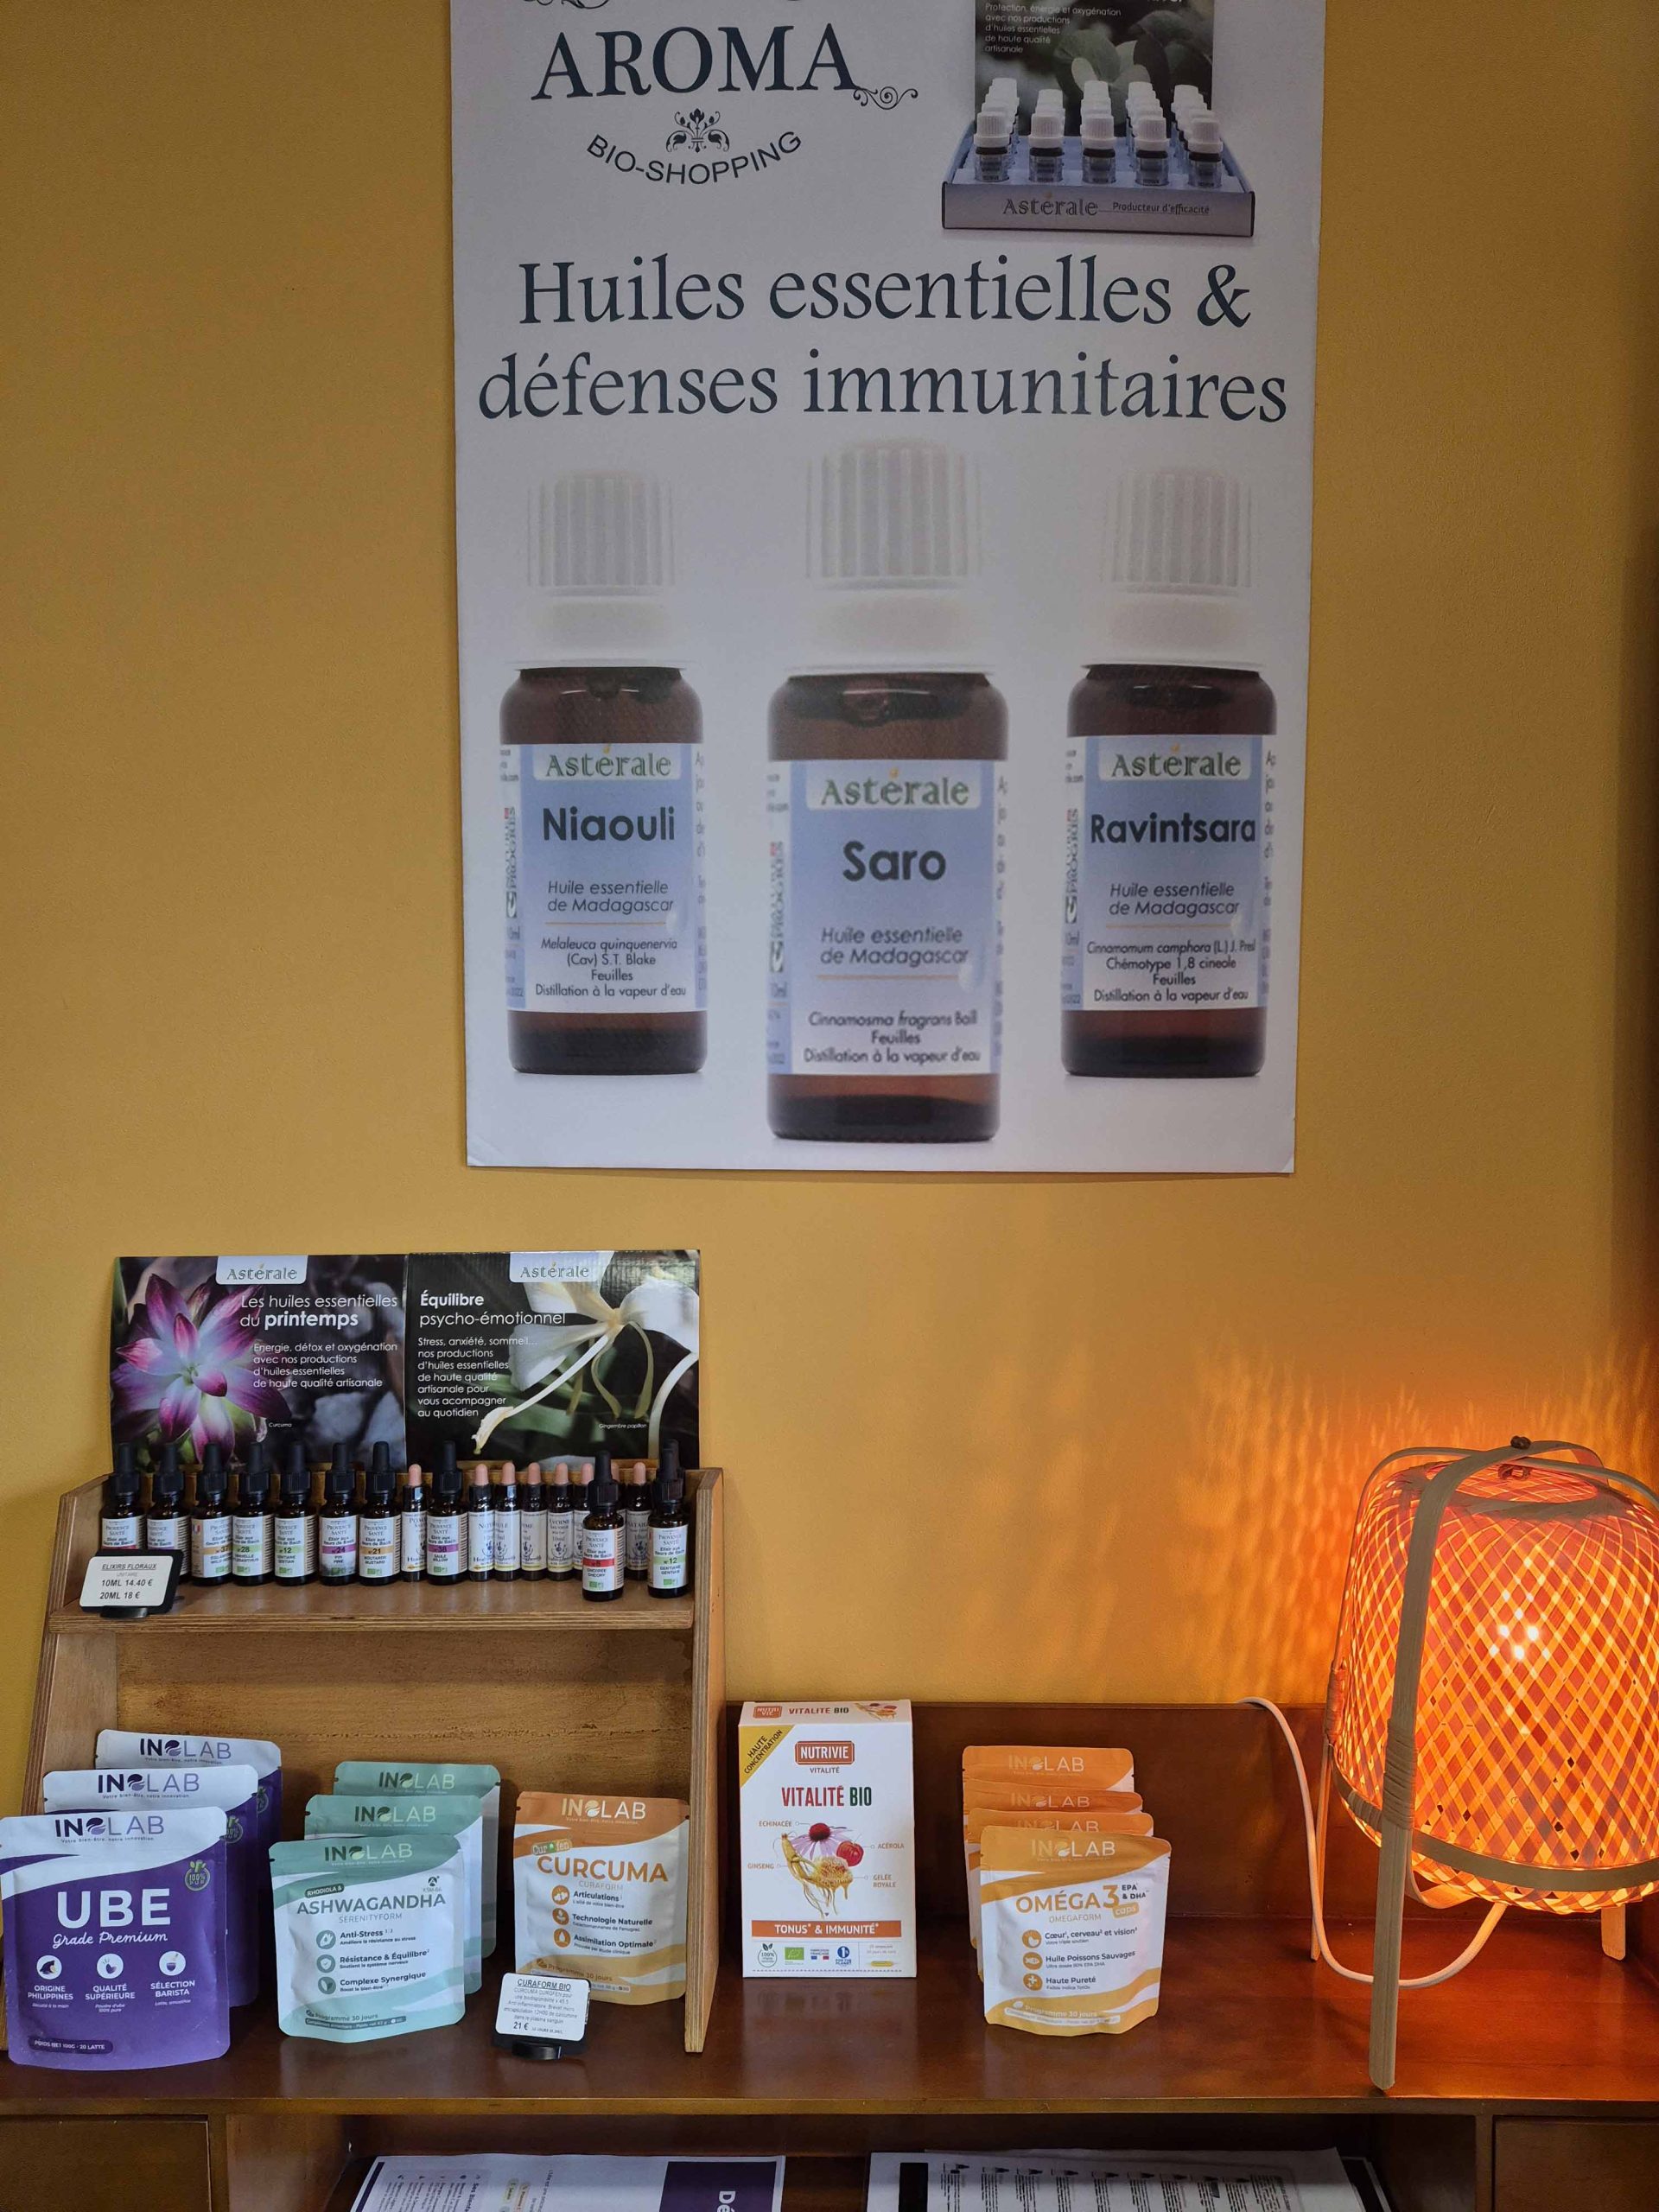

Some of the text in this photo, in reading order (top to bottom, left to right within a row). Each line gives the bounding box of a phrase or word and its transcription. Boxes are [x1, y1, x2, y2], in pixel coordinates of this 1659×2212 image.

[530, 22, 861, 100] AROMA
[587, 130, 802, 184] BIO-SHOPPING
[1003, 192, 1099, 216] Astérale
[1112, 201, 1160, 213] Producteur
[518, 252, 1251, 328] Huiles essentielles &
[479, 349, 1287, 423] défenses immunitaires
[545, 744, 671, 777] Astérale
[1111, 743, 1241, 777] Astérale
[821, 768, 969, 806] Astérale
[543, 805, 675, 842] Niaouli
[1090, 812, 1255, 843] Ravintsara
[842, 841, 946, 882] Saro
[548, 880, 668, 894] Huile essentielle
[1110, 882, 1235, 897] Huile essentielle
[548, 898, 673, 915] de Madagascar
[1109, 901, 1240, 918] de Madagascar
[822, 926, 963, 944] Huile essentielle
[541, 937, 677, 953] Melaleuca quinquenervia
[1087, 942, 1154, 955] Cinnamomum
[1157, 940, 1211, 957] camphora
[567, 953, 598, 967] (Cav)
[626, 954, 656, 965] Blake
[821, 948, 969, 967] de Madagascar
[1106, 957, 1171, 972] Chémotype
[591, 969, 632, 982] Feuilles
[1153, 972, 1196, 985] Feuilles
[536, 984, 686, 999] Distillation à la vapeur d'eau
[1094, 987, 1249, 1004] Distillation à la vapeur d'eau
[808, 1011, 893, 1027] Cinnamosma
[899, 1011, 951, 1030] fragrans
[871, 1031, 920, 1045] Feuilles
[804, 1047, 980, 1065] Distillation à la vapeur d'eau
[226, 1262, 298, 1281] Astérale
[519, 1262, 589, 1278] Astérale
[241, 1294, 397, 1308] Les huiles essentielles
[420, 1290, 485, 1308] Équilibre
[239, 1311, 359, 1330] du printemps
[420, 1313, 566, 1327] psycho-émotionnel
[295, 1342, 322, 1352] détox
[325, 1343, 335, 1352] et
[337, 1342, 397, 1354] oxygénation
[417, 1337, 446, 1346] Stress,
[448, 1337, 486, 1346] anxiété,
[300, 1354, 357, 1366] productions
[436, 1350, 493, 1359] productions
[253, 1366, 345, 1376] d'huiles essentielles
[417, 1361, 509, 1370] d'huiles essentielles
[253, 1377, 383, 1389] de haute qualité artisanale
[417, 1372, 499, 1384] de haute qualité
[417, 1385, 489, 1395] artisanale pour
[433, 1408, 479, 1419] quotidien
[744, 1729, 783, 1774] CONCENTRATION
[747, 1735, 767, 1758] HAUTE
[800, 1746, 849, 1759] NUTRIVIE
[781, 1785, 872, 1808] VITALITÉ BIO
[537, 1855, 669, 1883] CURCUMA
[57, 1888, 171, 1929] UBE
[297, 1893, 446, 1915] ASHWAGANDHA
[1116, 1904, 1136, 1915] caps
[339, 1912, 403, 1923] SERENITYFORM
[572, 1914, 616, 1924] Technologie
[1049, 1914, 1102, 1923] OMEGAFORM
[340, 1929, 384, 1938] Anti-Stress
[815, 1924, 822, 1934] &
[53, 1931, 168, 1949] Grade Premium
[574, 1935, 616, 1947] Assimilation
[1102, 1950, 1135, 1961] Sauvages
[150, 1980, 195, 1990] SÉLECTION
[340, 1971, 426, 1988] Complexe Synergique
[518, 1978, 571, 1991] CURAFORM BIO
[1071, 1975, 1096, 1984] Pureté
[28, 1992, 73, 2000] PHILIPPINES
[85, 1992, 136, 2000] SUPÉRIEURE
[92, 1984, 127, 1993] QUALITÉ
[155, 1988, 190, 1998] BARISTA
[513, 2021, 529, 2031] 21 €
